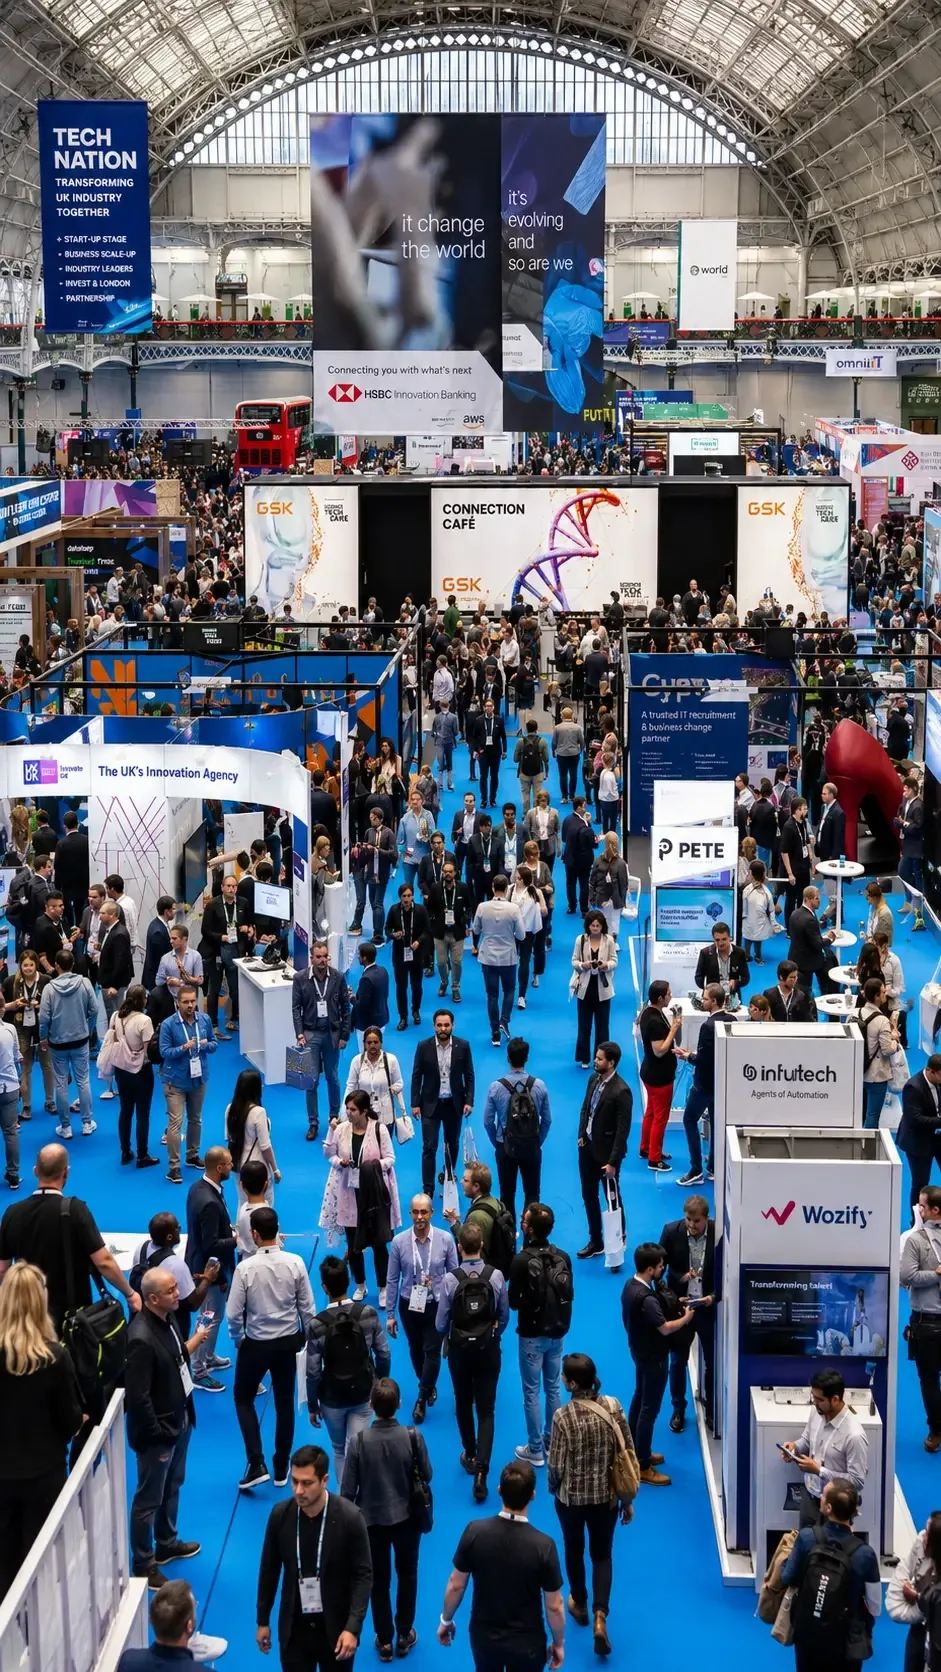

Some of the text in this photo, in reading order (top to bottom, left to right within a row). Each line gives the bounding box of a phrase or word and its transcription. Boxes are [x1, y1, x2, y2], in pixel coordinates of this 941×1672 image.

[53, 128, 111, 146] TECH
[54, 150, 137, 169] NATION
[55, 178, 134, 187] TRANSFORMING
[56, 193, 122, 202] UK INDUSTRY
[508, 190, 528, 205] it's
[57, 208, 110, 217] TOGETHER
[402, 214, 485, 237] it change
[508, 212, 564, 231] evolving
[64, 235, 127, 243] START-UP STAGE
[508, 233, 534, 249] and
[101, 250, 136, 258] SCALE-UP
[402, 240, 486, 259] the world
[65, 265, 100, 273] INDUSTRY
[508, 258, 573, 271] so are we
[701, 264, 728, 275] world
[65, 280, 91, 288] INVEST
[327, 365, 472, 376] Connecting you with what's next
[364, 389, 477, 401] HSBC Innovation Banking
[462, 414, 485, 424] aws
[256, 501, 293, 515] GSK
[442, 503, 526, 515] CONNECTION
[748, 502, 786, 516] GSK
[442, 516, 476, 530] CAFÉ
[442, 577, 482, 592] GSK
[641, 710, 737, 720] A trusted IT recruitment
[684, 722, 713, 733] change
[641, 735, 671, 744] partner
[98, 765, 239, 784] The UK's Innovation Agency
[679, 842, 725, 859] PETE
[751, 1090, 829, 1100] Agents of Automation
[802, 1205, 867, 1229] Wozify
